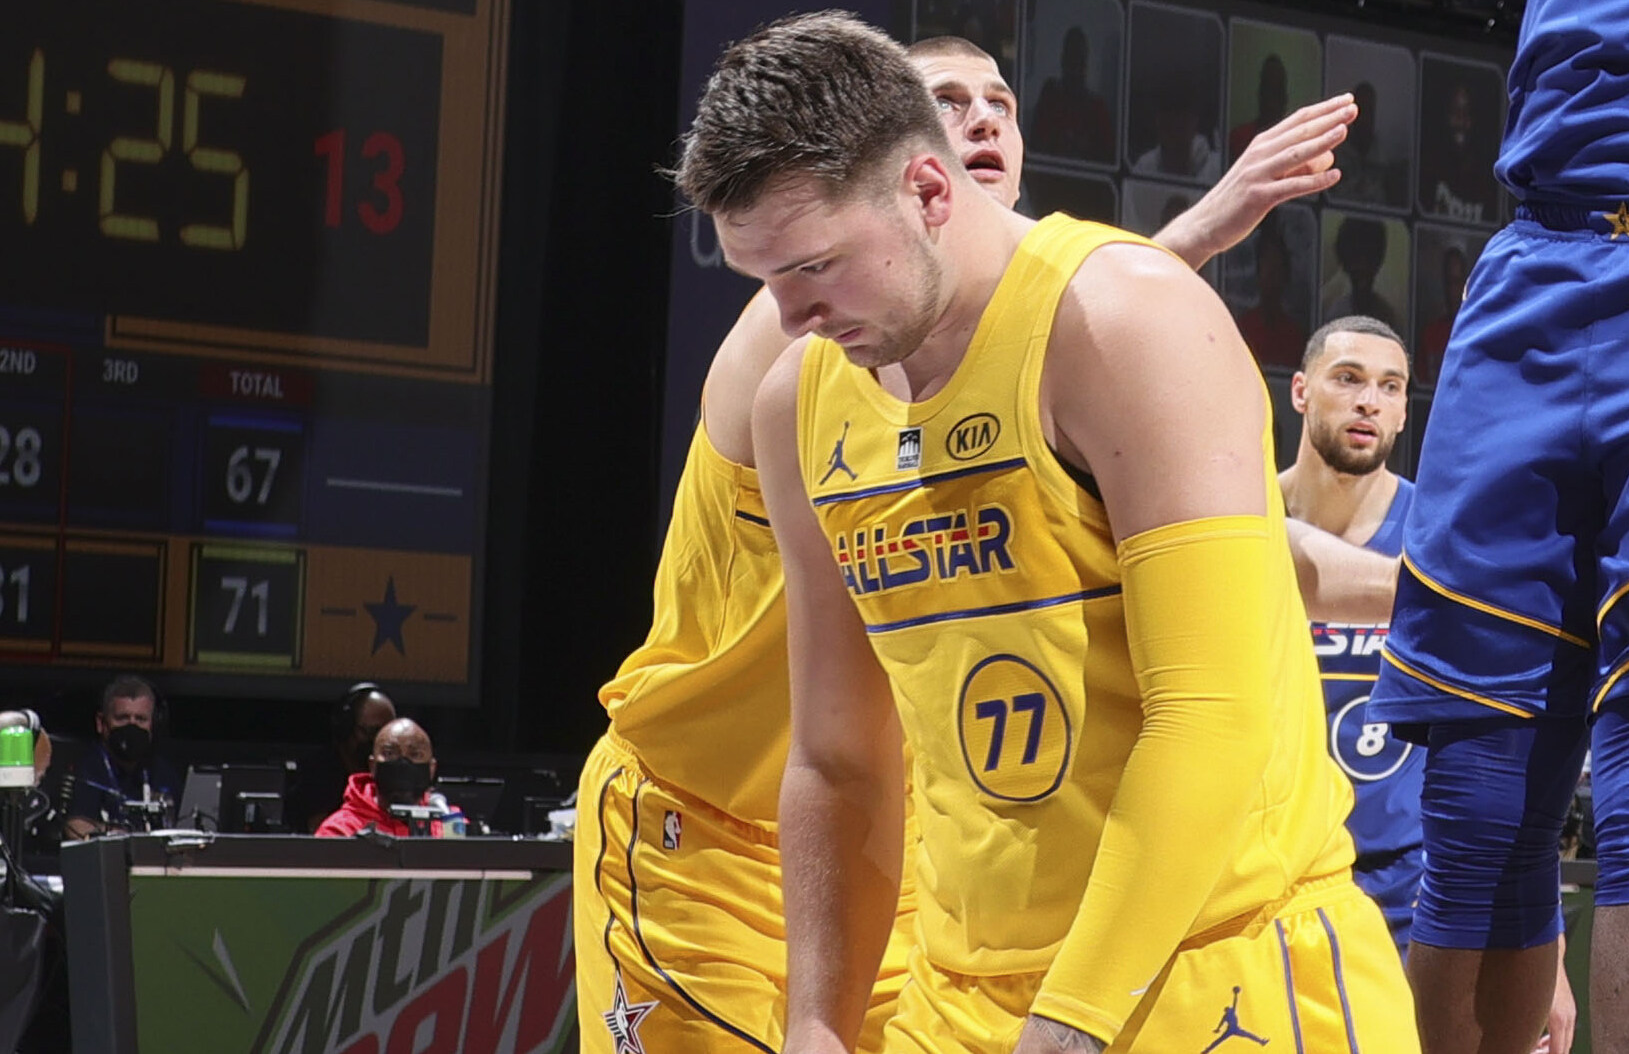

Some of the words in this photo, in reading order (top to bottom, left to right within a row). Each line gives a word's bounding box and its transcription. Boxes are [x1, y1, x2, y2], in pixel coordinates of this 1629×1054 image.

[313, 129, 405, 234] 13
[103, 358, 139, 384] 3RD
[229, 371, 285, 400] TOTAL
[225, 446, 282, 505] 67
[219, 576, 270, 636] 71
[975, 692, 1047, 773] 77
[1356, 722, 1388, 757] 8
